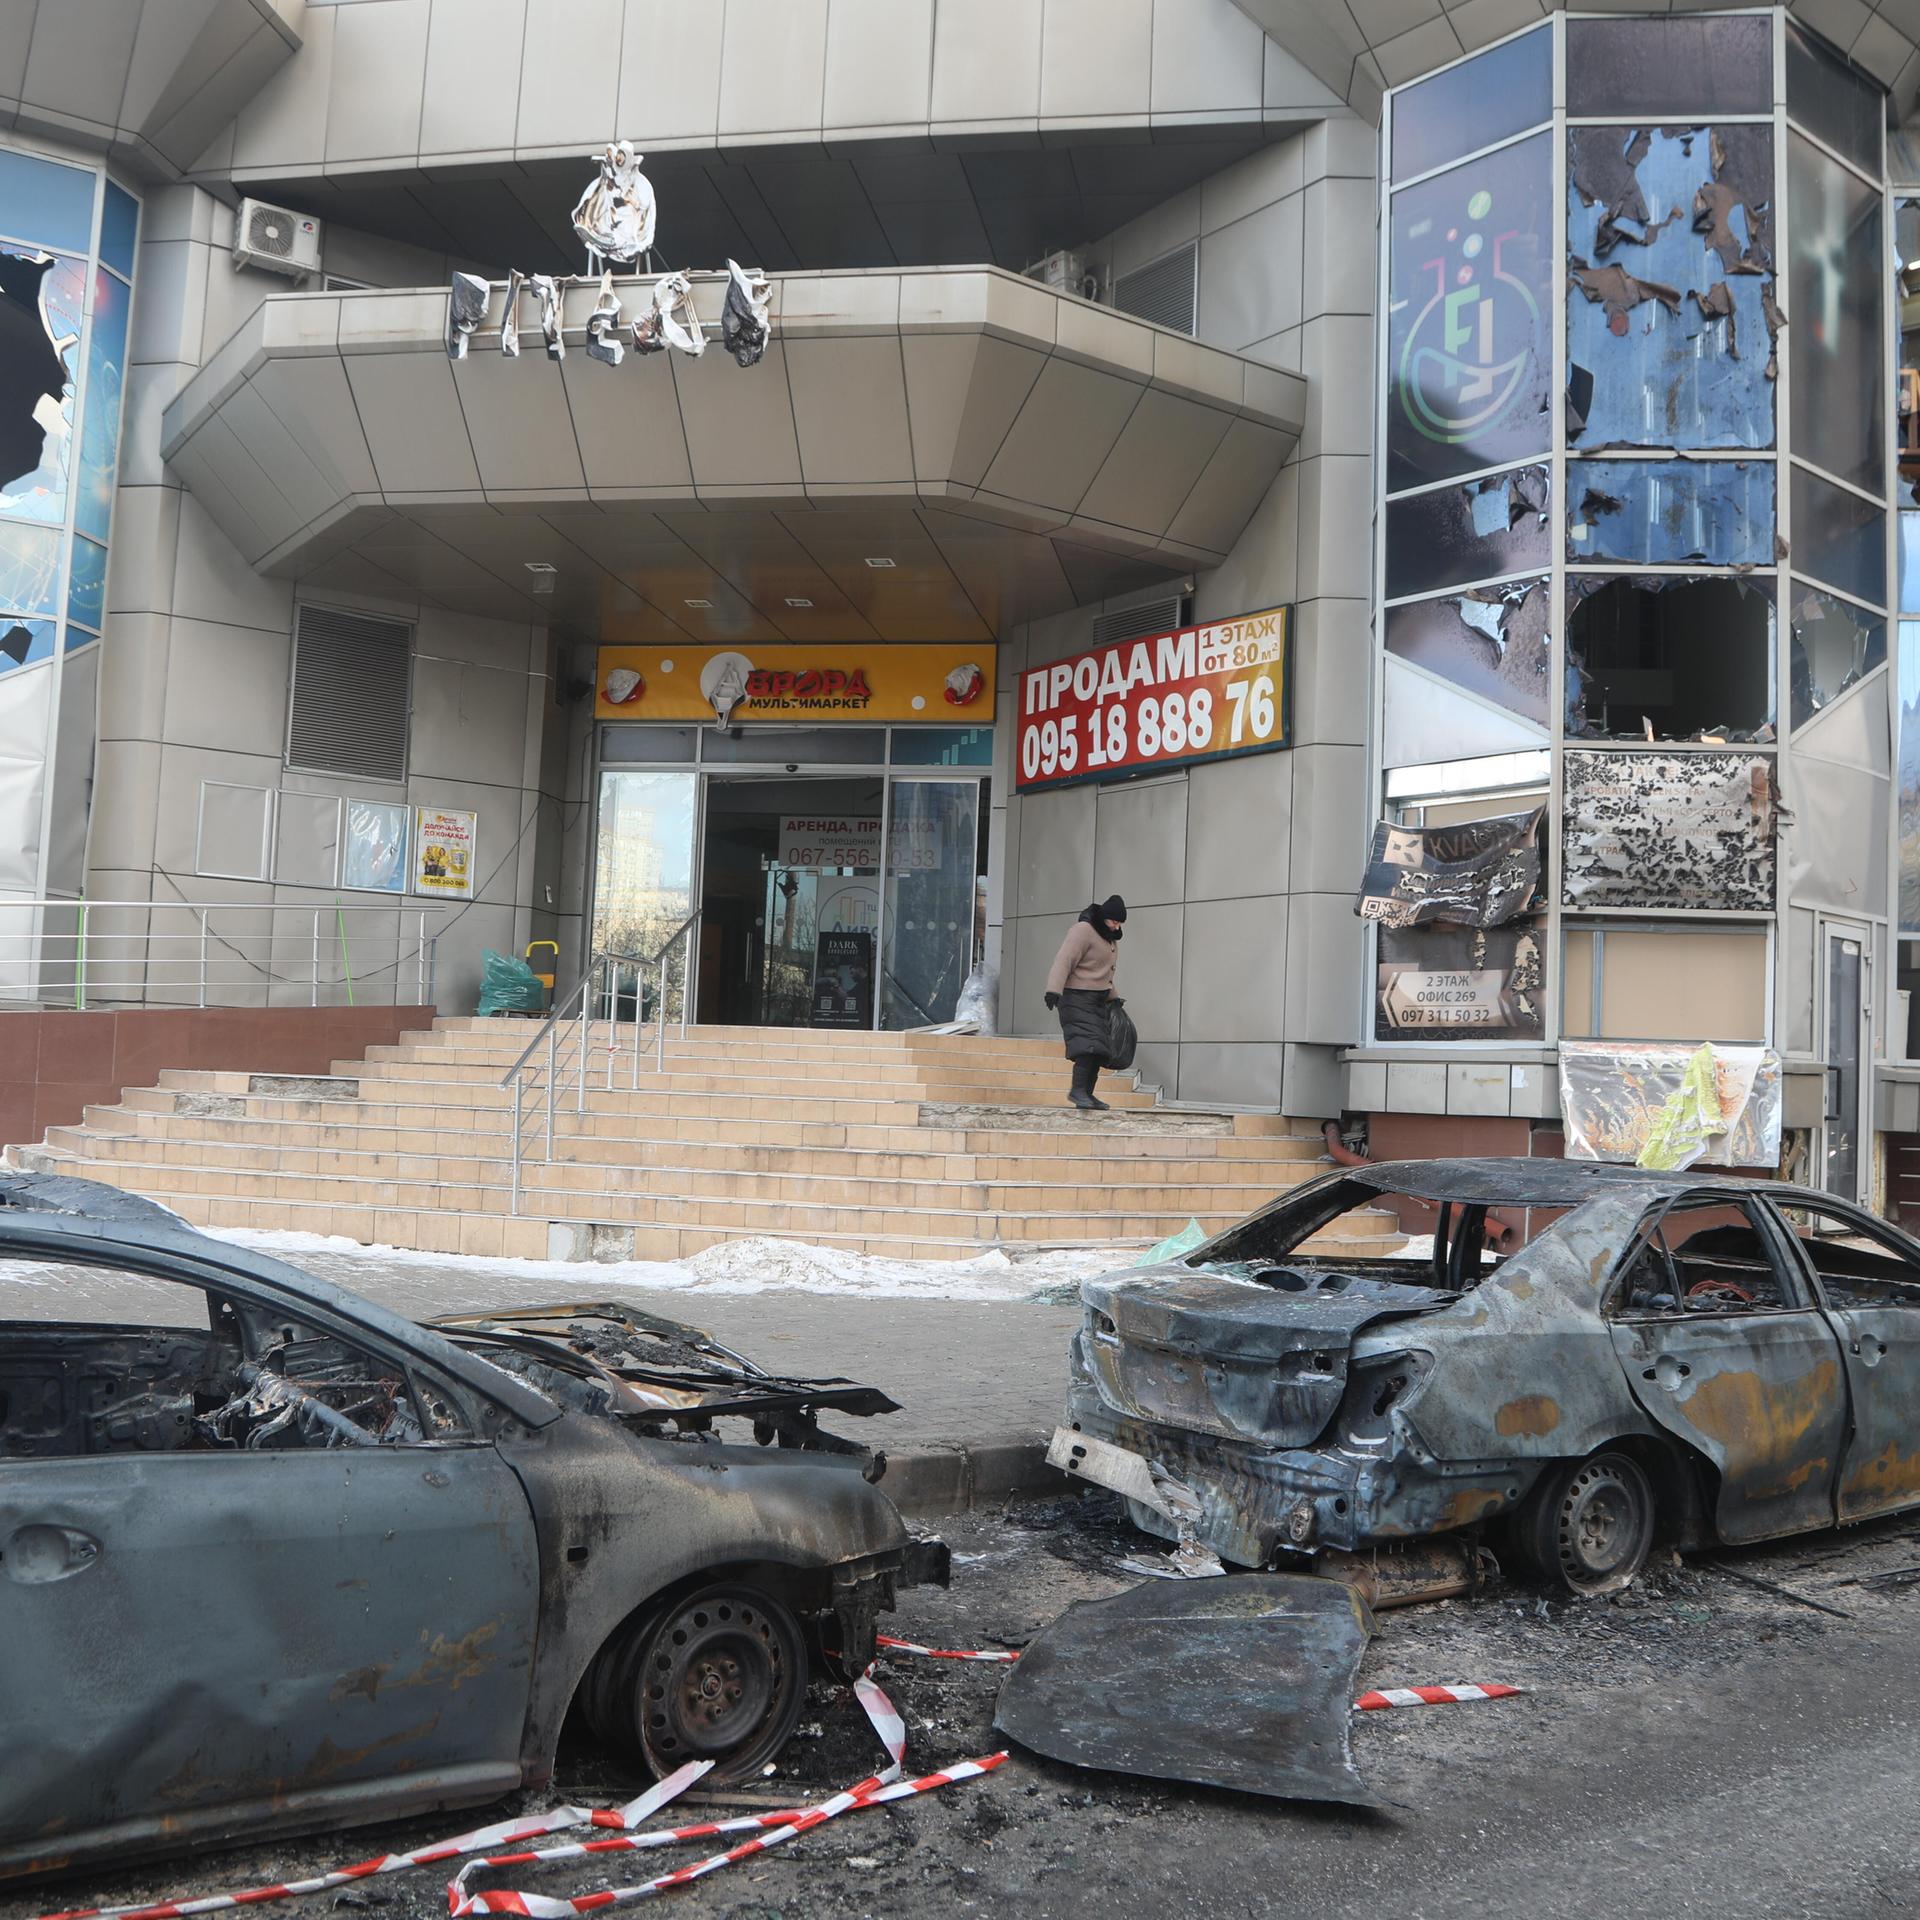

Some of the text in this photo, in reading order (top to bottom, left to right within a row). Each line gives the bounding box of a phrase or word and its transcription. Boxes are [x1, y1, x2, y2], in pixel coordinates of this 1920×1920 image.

[1202, 617, 1276, 649] 1 ЭТАЖ
[1232, 642, 1258, 665] 80
[1026, 631, 1195, 715] ПРОДАМ
[749, 698, 870, 709] МУЛЬТИМАРКЕТ
[1023, 675, 1275, 779] 095 18 888 76
[786, 820, 853, 834] АРЕНДА,
[788, 848, 936, 867] 067-556-0-53
[829, 940, 858, 949] DARK
[1427, 976, 1470, 987] 2 ЭТАЖ
[1417, 991, 1476, 1002] ОФИС 269
[1402, 1010, 1489, 1022] 097 311 50 32
